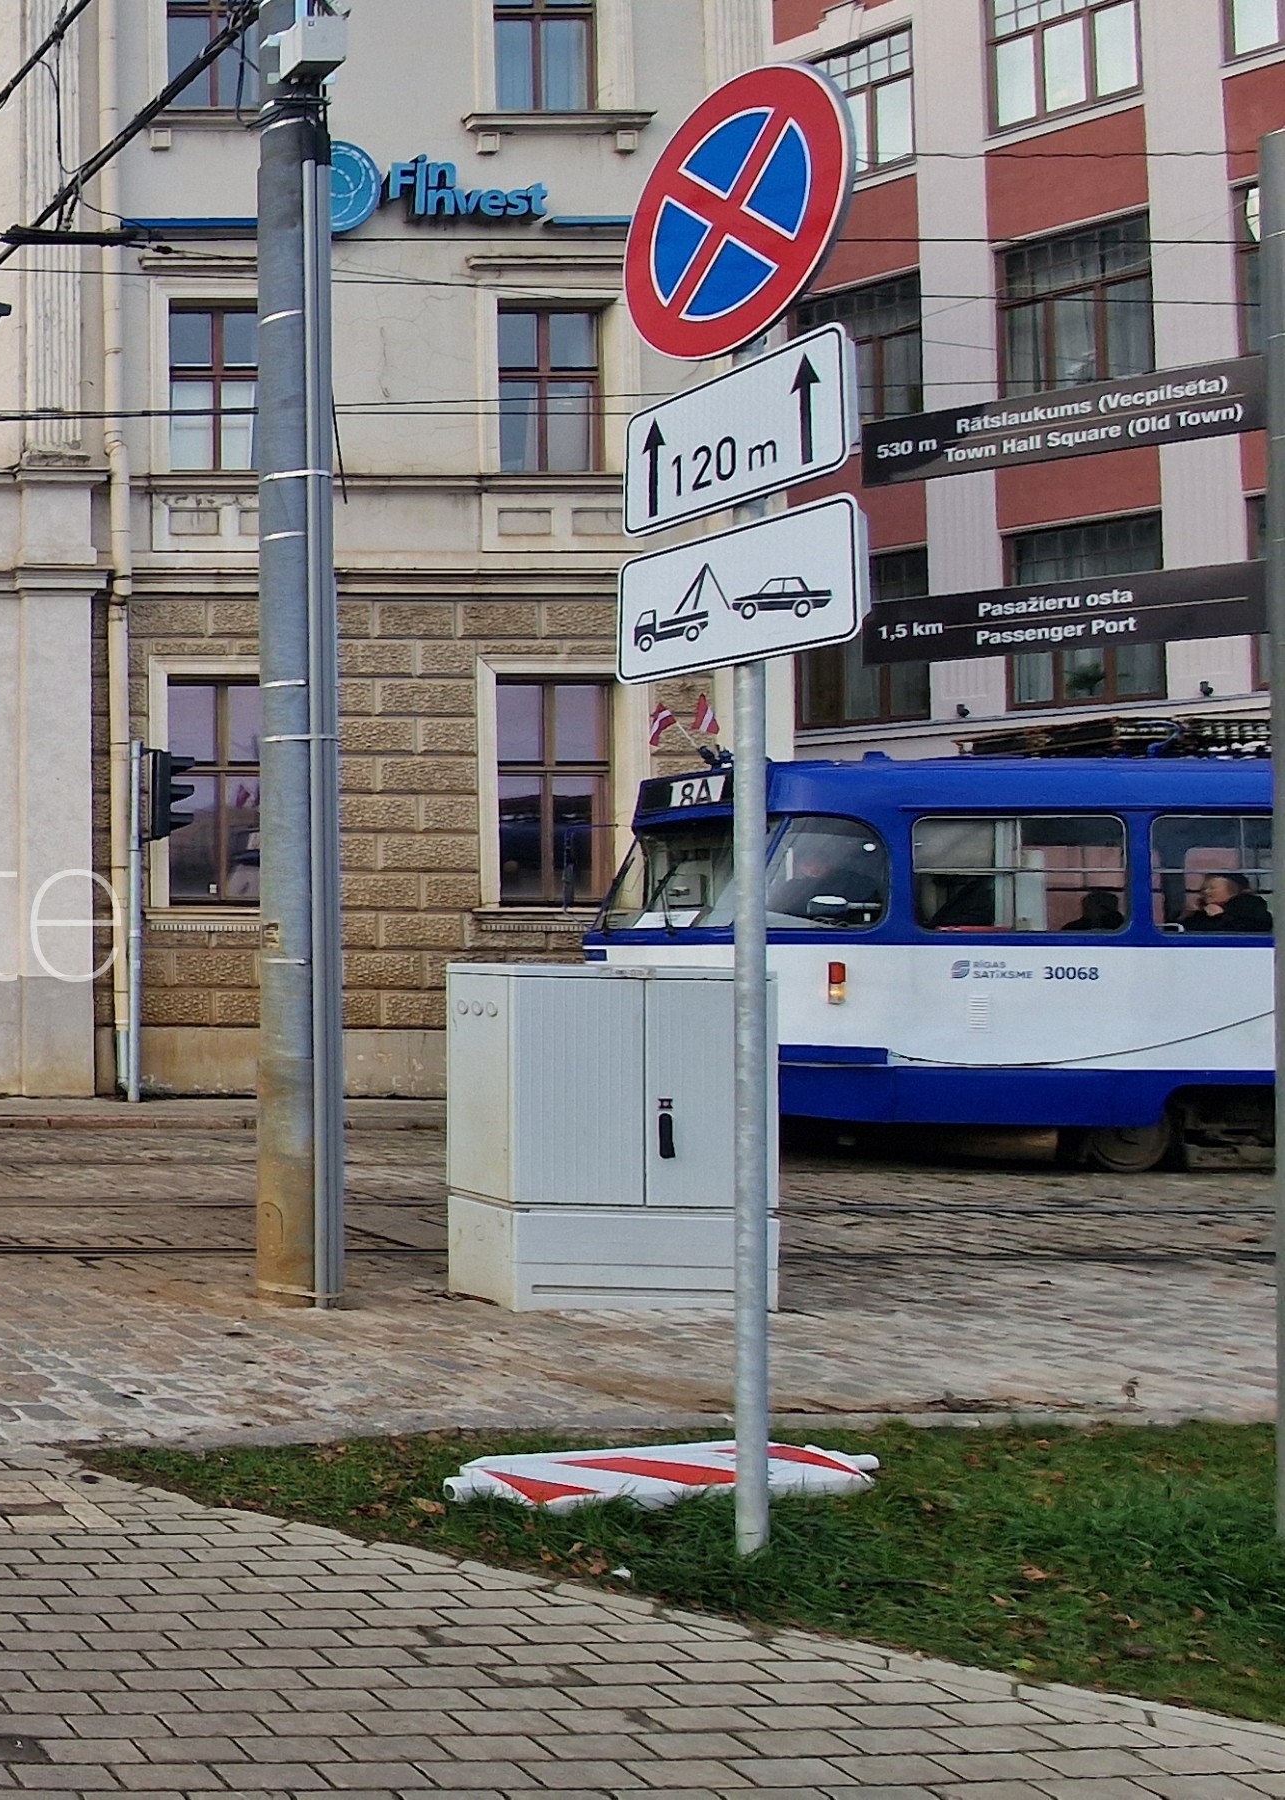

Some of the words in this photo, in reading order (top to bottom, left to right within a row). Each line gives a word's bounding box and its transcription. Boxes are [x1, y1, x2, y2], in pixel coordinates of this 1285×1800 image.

[388, 153, 457, 201] Fin
[956, 400, 1093, 434] Rātslaukums
[1098, 376, 1229, 414] (Vecpilsēta)
[943, 444, 997, 463] Town
[1002, 434, 1042, 455] Hall
[1047, 424, 1122, 448] Square
[1128, 413, 1171, 438] (Old
[1176, 403, 1244, 427] Town)
[876, 440, 913, 459] 530
[918, 438, 938, 453] m
[671, 435, 737, 497] 120
[748, 439, 777, 472] m
[977, 594, 1080, 618] Pasažieru
[1086, 588, 1134, 607] osta
[878, 625, 908, 641] 1,5
[912, 621, 944, 637] km
[976, 621, 1087, 646] Passenger
[1091, 616, 1138, 635] Port
[679, 778, 713, 807] 8A
[1043, 966, 1100, 980] 30068
